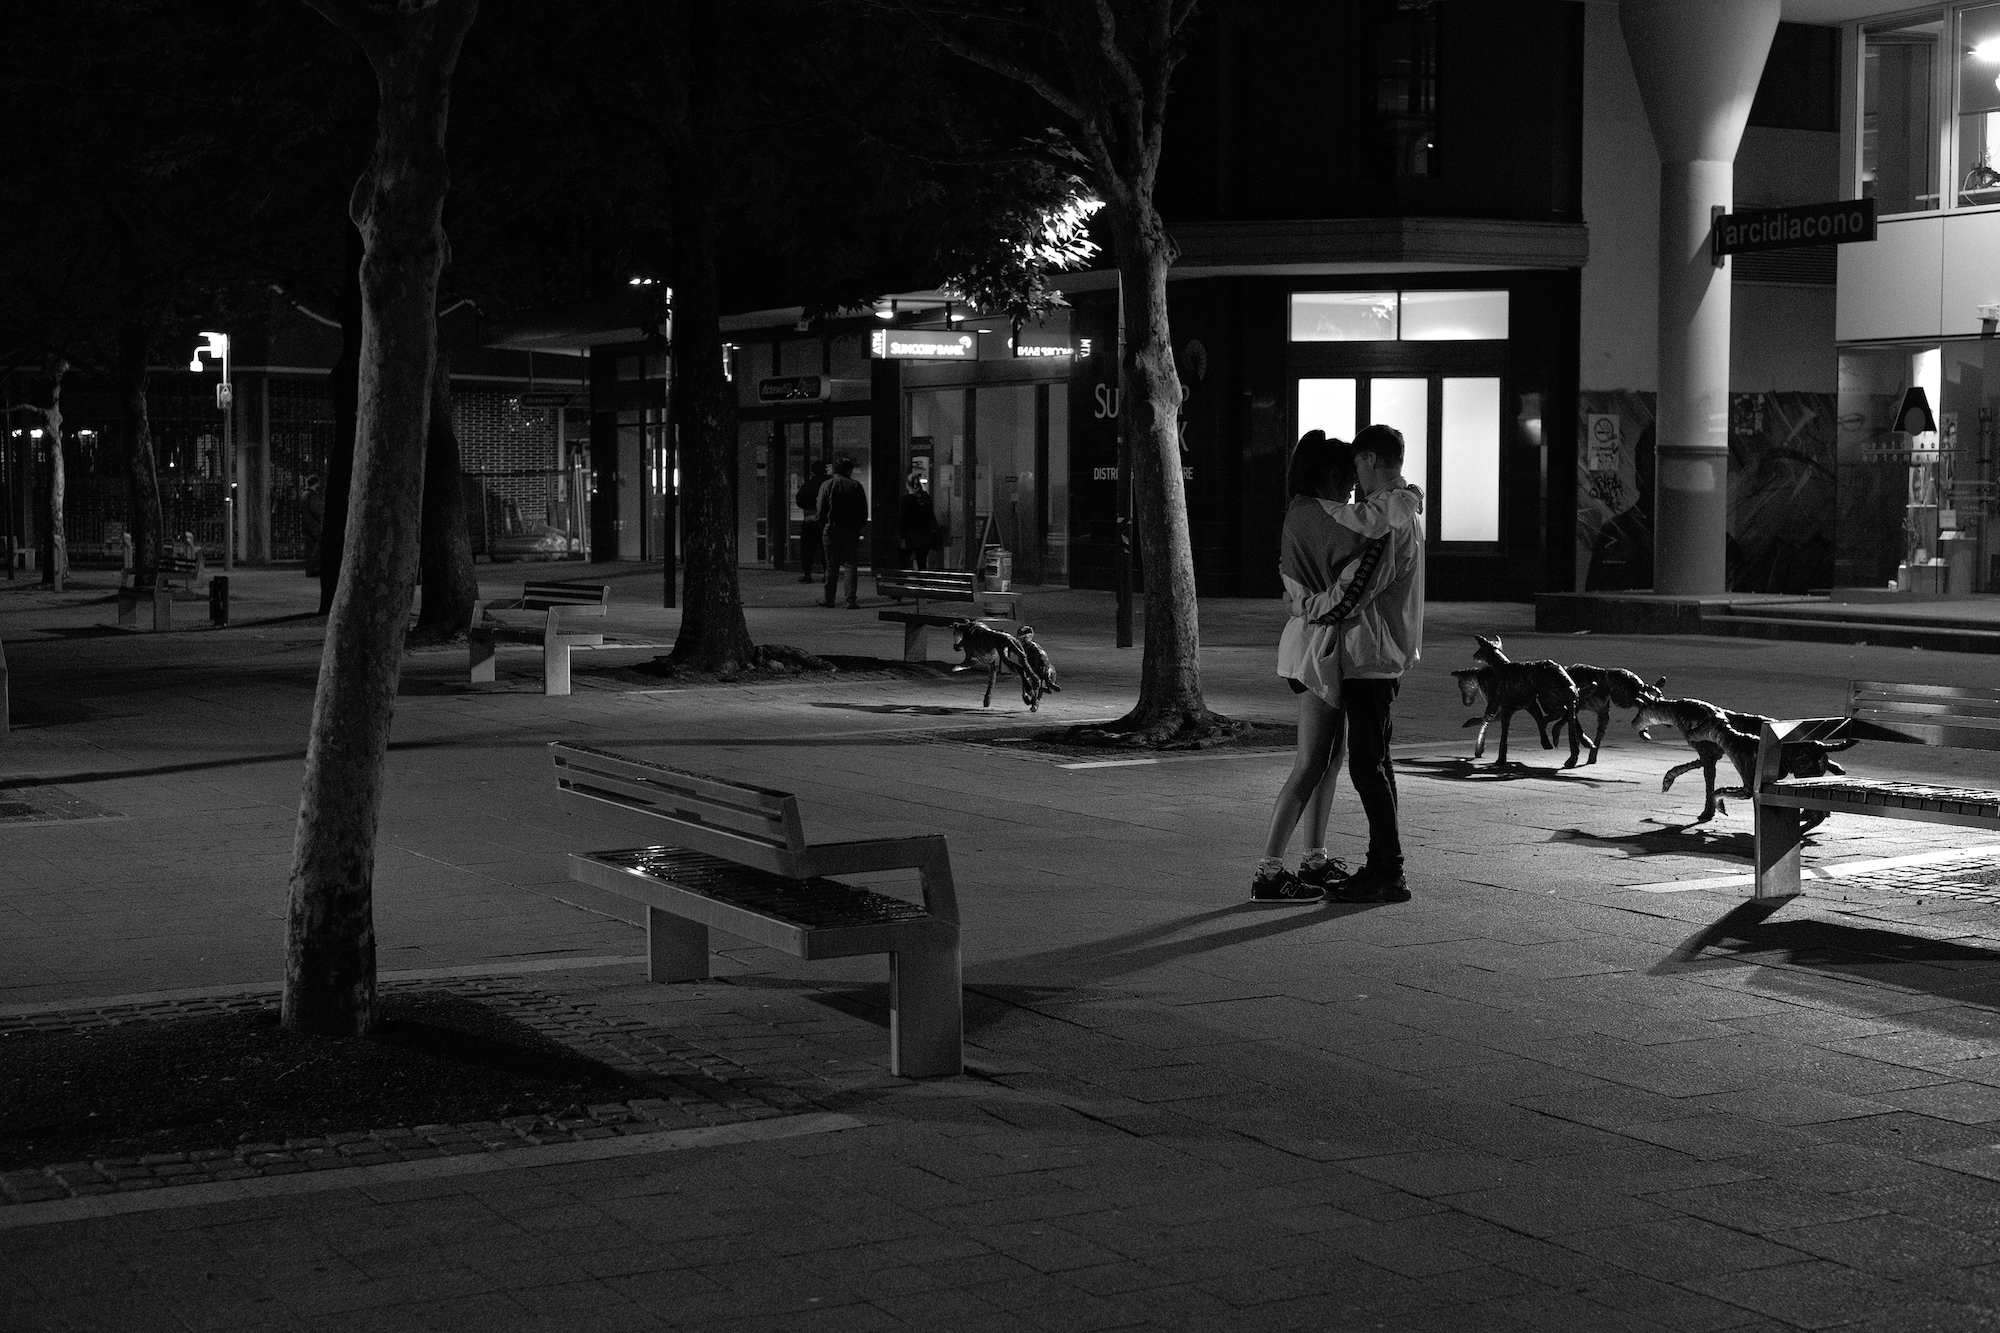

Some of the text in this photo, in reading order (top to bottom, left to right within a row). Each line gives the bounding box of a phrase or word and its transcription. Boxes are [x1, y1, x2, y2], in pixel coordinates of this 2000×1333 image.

[1725, 211, 1864, 246] arcidiacono
[872, 332, 883, 355] ATM
[1093, 467, 1119, 480] DISTRI
